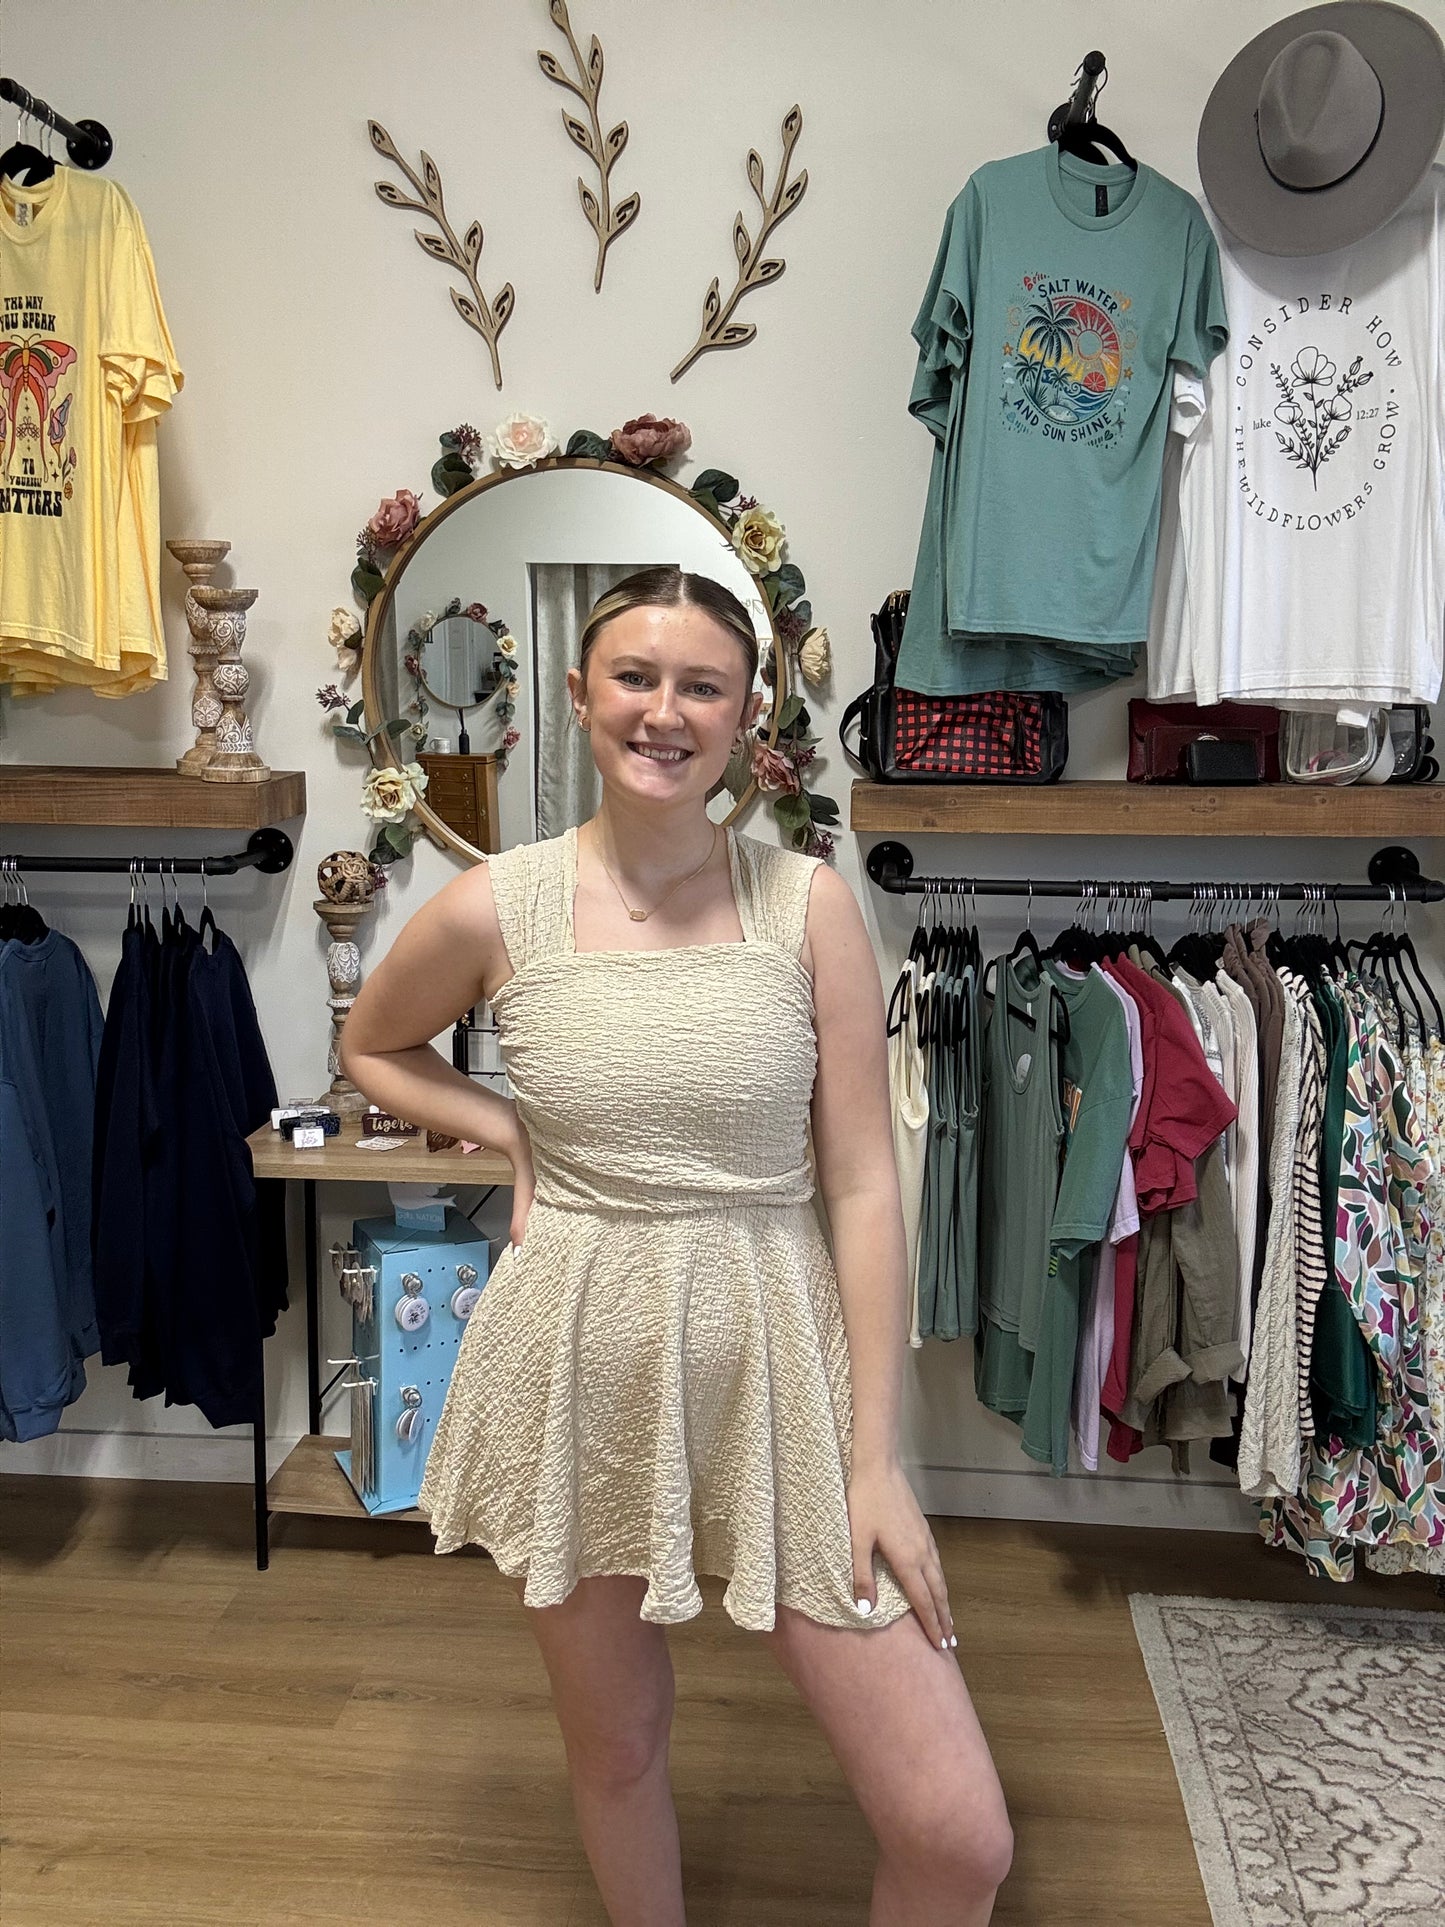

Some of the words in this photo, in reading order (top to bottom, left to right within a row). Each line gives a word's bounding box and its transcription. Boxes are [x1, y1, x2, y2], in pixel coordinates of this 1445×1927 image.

[4, 295, 23, 310] THE
[25, 295, 44, 310] WAY
[1038, 279, 1070, 298] SALT
[1076, 280, 1118, 315] WATER
[22, 312, 56, 332] SPEAK
[1236, 294, 1353, 387] CONSIDER
[1366, 315, 1402, 368] HOW
[1013, 398, 1039, 426] AND
[1042, 424, 1066, 442] SUN
[1071, 412, 1112, 442] SHINE
[1356, 408, 1379, 420] 12:27
[1235, 425, 1246, 469] THE
[1373, 400, 1400, 470] GROW
[22, 458, 35, 475] TO
[0, 488, 63, 516] ATTERS
[1239, 475, 1373, 531] WILDFLOWERS
